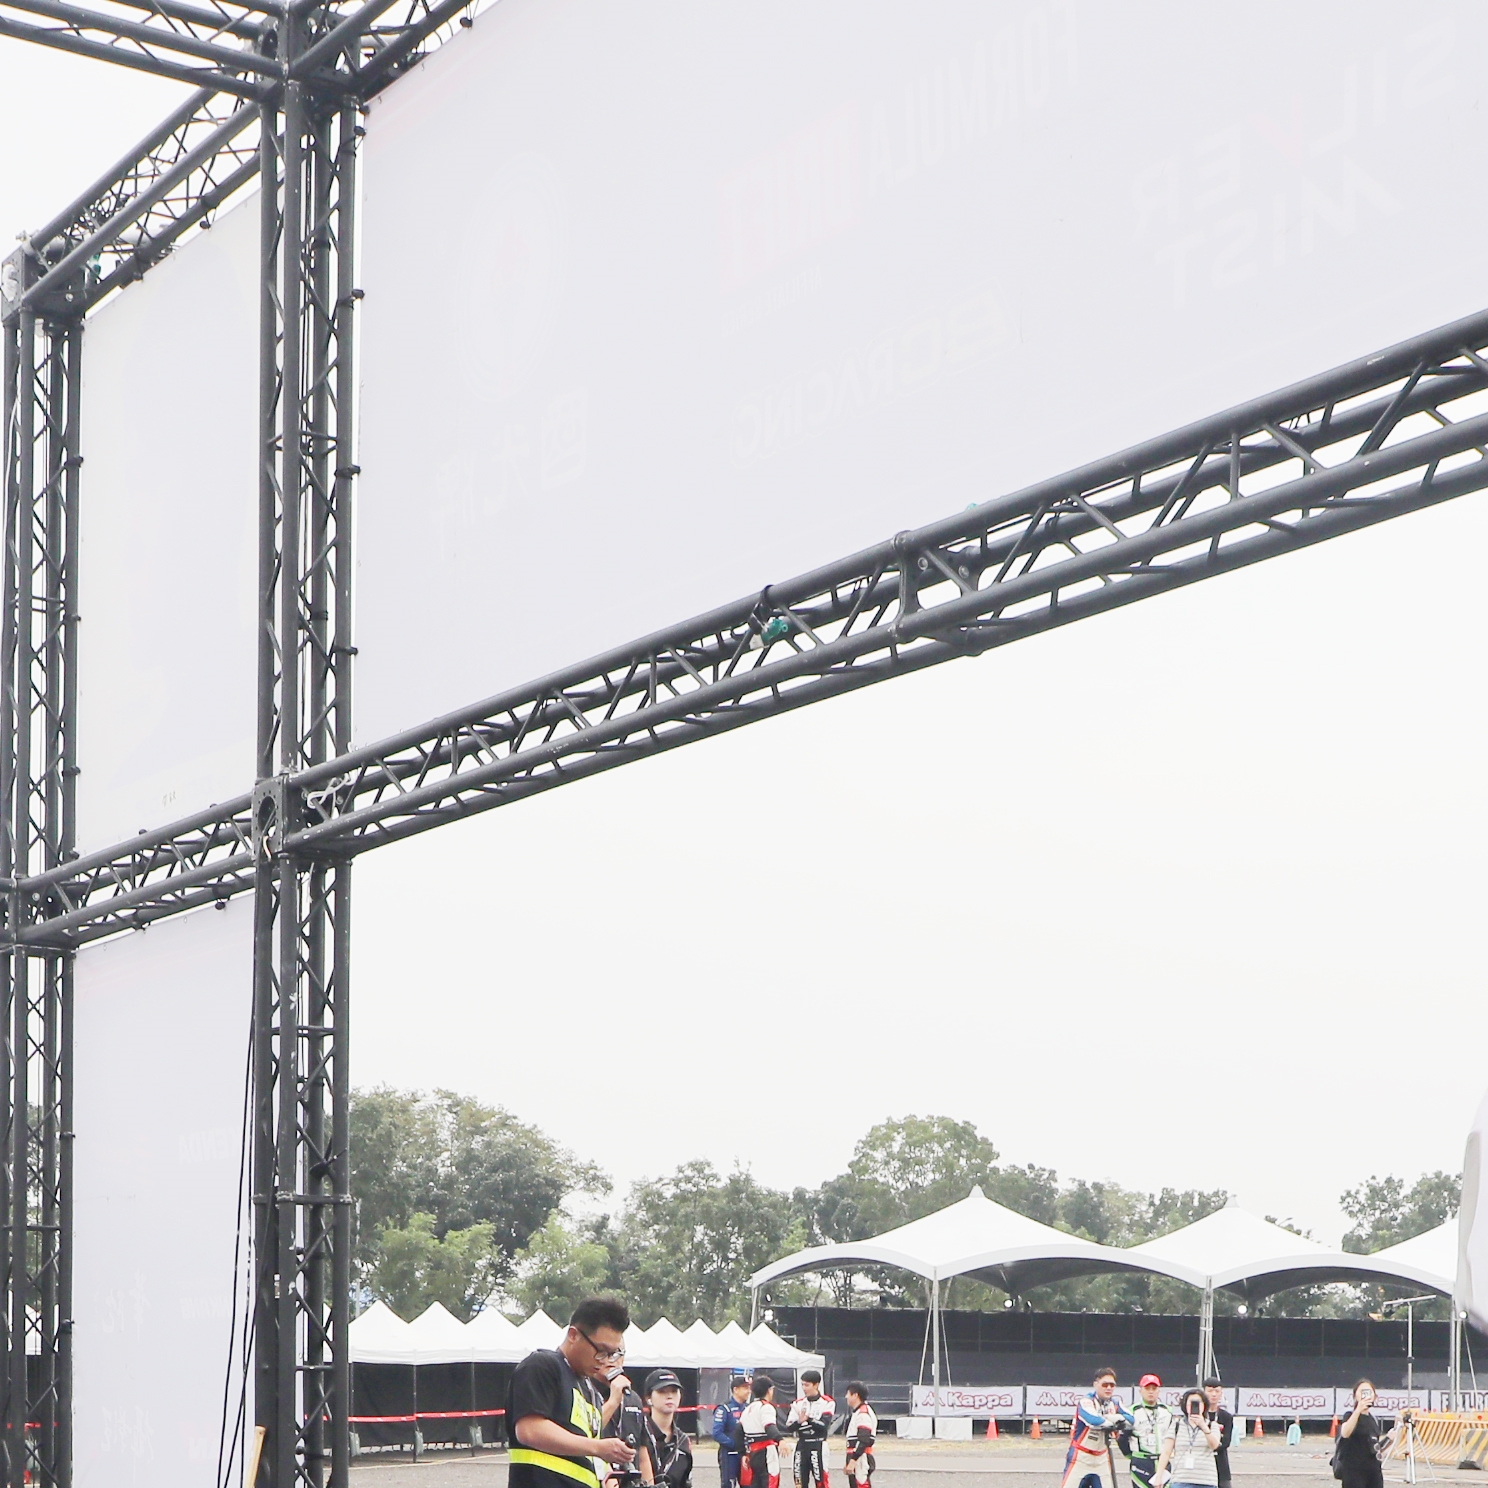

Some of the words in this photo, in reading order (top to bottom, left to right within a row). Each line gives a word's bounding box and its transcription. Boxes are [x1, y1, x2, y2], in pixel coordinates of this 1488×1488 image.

[947, 1391, 1013, 1410] Kappa
[1269, 1392, 1325, 1410] Kappa
[1373, 1394, 1420, 1411] appa
[1441, 1393, 1475, 1413] FLL
[810, 1450, 821, 1481] KENDA
